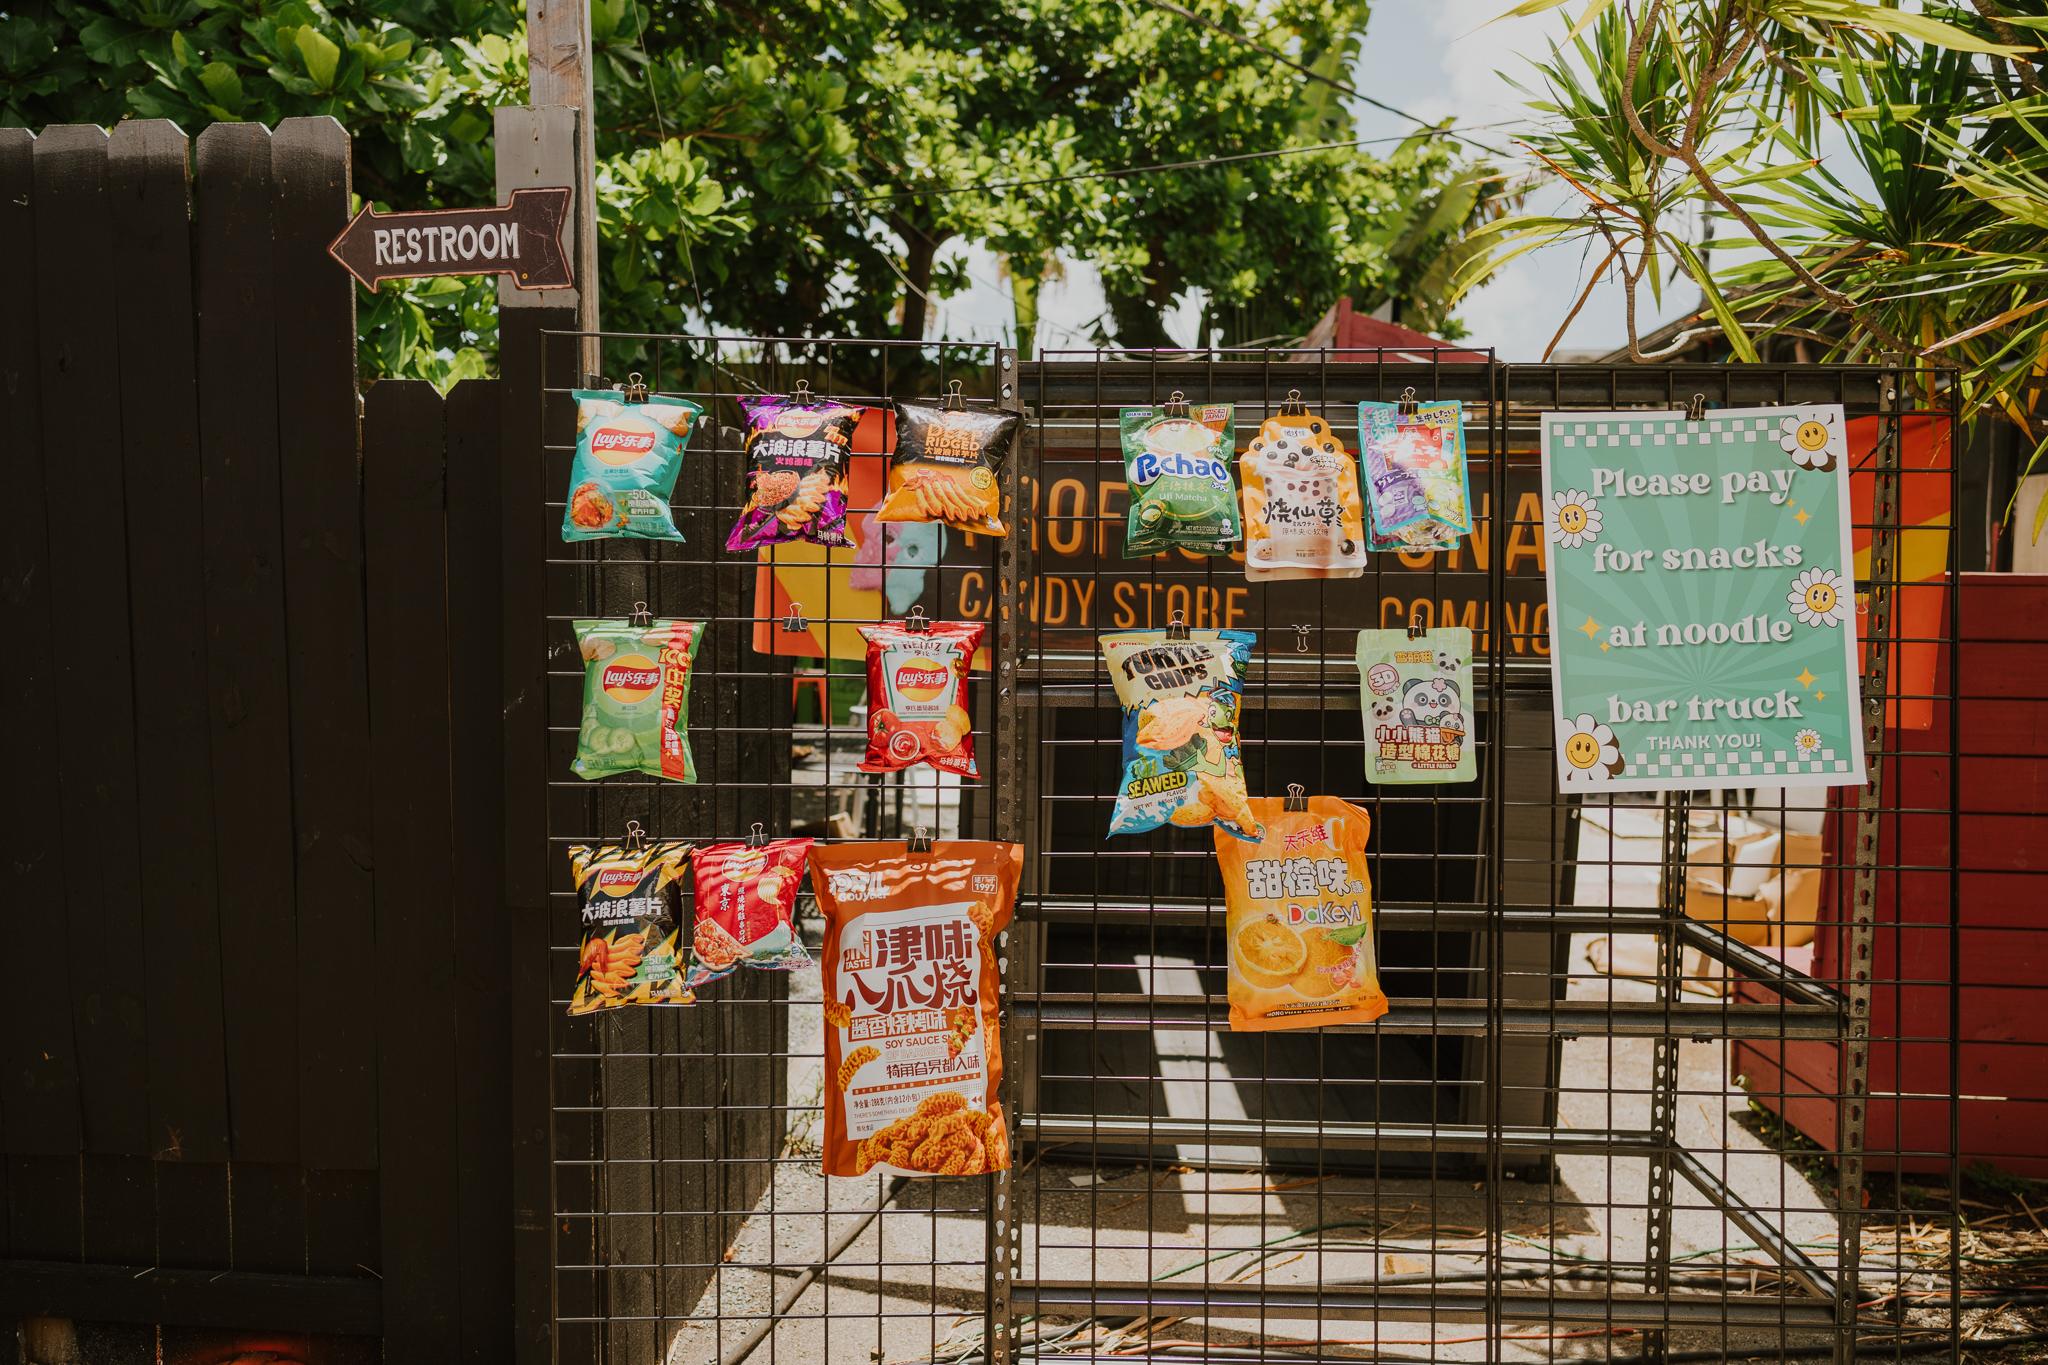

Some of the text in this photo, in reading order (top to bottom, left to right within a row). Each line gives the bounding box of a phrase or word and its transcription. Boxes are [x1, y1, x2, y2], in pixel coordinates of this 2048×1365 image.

[374, 222, 520, 266] RESTROOM
[593, 432, 625, 449] Lay's
[753, 439, 841, 463] 大波浪薯片
[925, 436, 980, 451] RIDGED
[1591, 467, 1797, 504] Please pay
[1593, 538, 1803, 572] for snacks
[1609, 615, 1793, 647] at noodle
[1121, 645, 1215, 681] TURTLE
[605, 671, 660, 686] Lay's 乐事
[898, 671, 948, 687] Lay's 乐事
[1144, 663, 1208, 690] CHIPS
[1370, 669, 1396, 687] 3D
[1607, 689, 1804, 724] bar truck
[1375, 725, 1441, 744] 小小熊猫
[1646, 734, 1762, 750] THANK YOU!
[1381, 743, 1460, 761] 造型棉花糖
[1128, 771, 1187, 799] SEAWEED
[601, 872, 624, 885] Lay's
[974, 883, 995, 891] 1997
[1246, 857, 1351, 899] 甜橙味
[582, 897, 662, 921] 大波浪薯片
[1287, 900, 1362, 926] DaKeyi
[876, 919, 973, 967] 津味
[846, 959, 870, 968] TASTE
[851, 1010, 947, 1040] 酱香烧烤味
[885, 1039, 904, 1049] SOY
[906, 1035, 940, 1047] SAUCE
